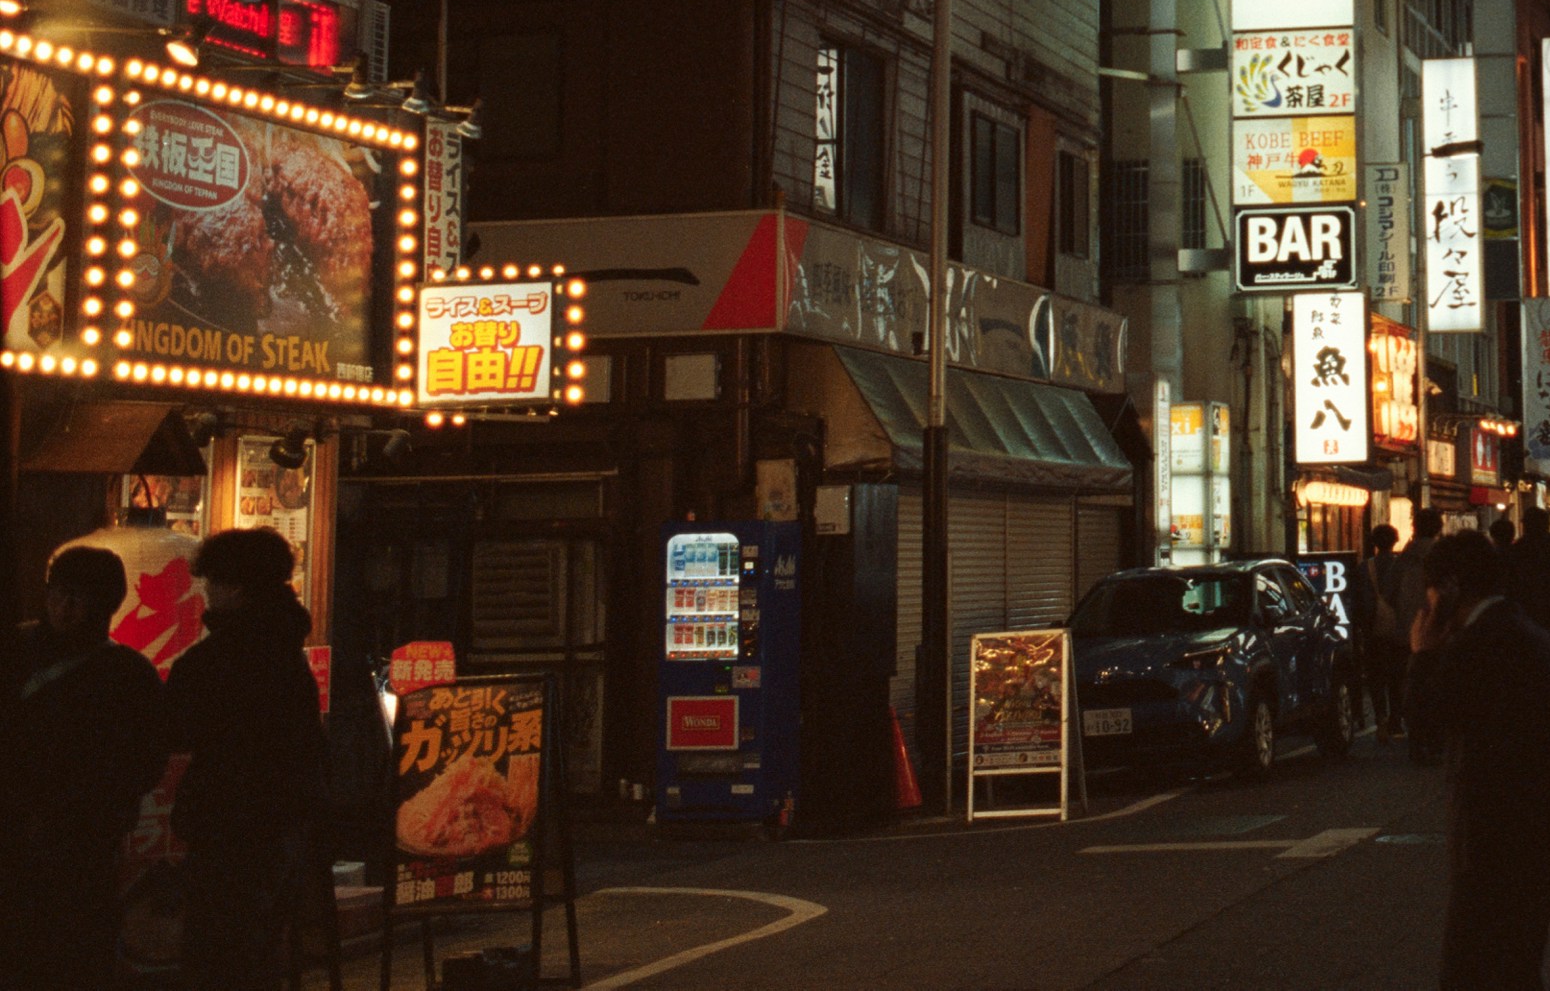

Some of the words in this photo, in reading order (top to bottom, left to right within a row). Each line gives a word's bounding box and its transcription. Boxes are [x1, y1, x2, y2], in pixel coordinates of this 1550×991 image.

[1277, 49, 1351, 78] くじゃく
[1285, 84, 1325, 109] 茶屋
[1329, 93, 1351, 107] 2F
[1245, 132, 1291, 150] KOBE
[1299, 130, 1344, 148] BEEF
[1246, 151, 1300, 171] 神戸牛
[1240, 184, 1256, 198] 1F
[1247, 214, 1343, 263] BAR
[425, 292, 549, 319] ライス&スープ
[122, 319, 222, 361] INGDOM
[226, 333, 254, 365] OF
[261, 333, 331, 374] STEAK
[449, 320, 521, 350] お替り
[426, 345, 544, 395] 自由!!
[1310, 345, 1352, 431] 魚八
[392, 659, 455, 682] 新発売
[429, 687, 508, 715] あと引く
[400, 708, 543, 777] ガッツリ系
